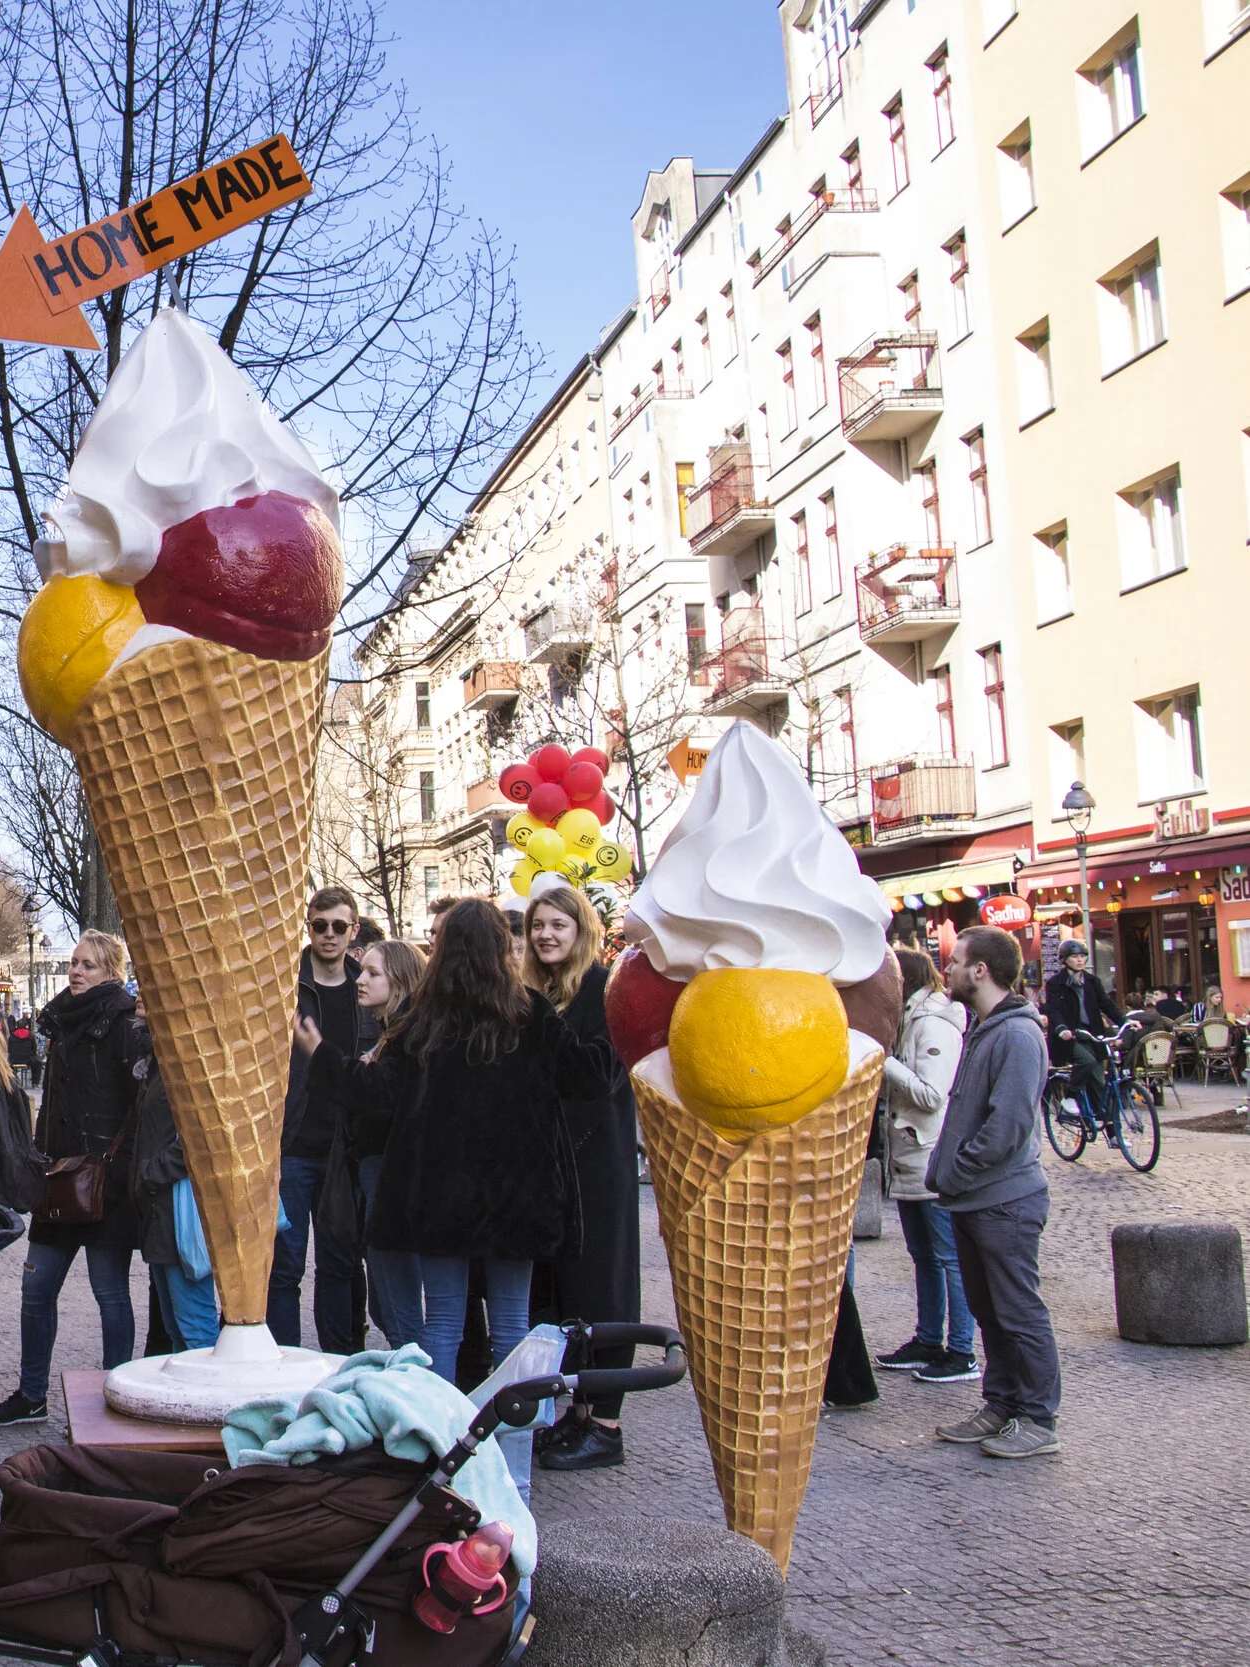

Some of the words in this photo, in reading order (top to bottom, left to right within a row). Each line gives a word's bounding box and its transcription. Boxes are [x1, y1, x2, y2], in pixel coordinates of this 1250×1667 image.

[33, 197, 174, 297] HOME
[172, 138, 303, 232] MADE
[686, 751, 710, 769] HOM
[1153, 799, 1210, 842] Sadhu
[579, 834, 595, 846] EIS
[986, 904, 1026, 923] Sadhu
